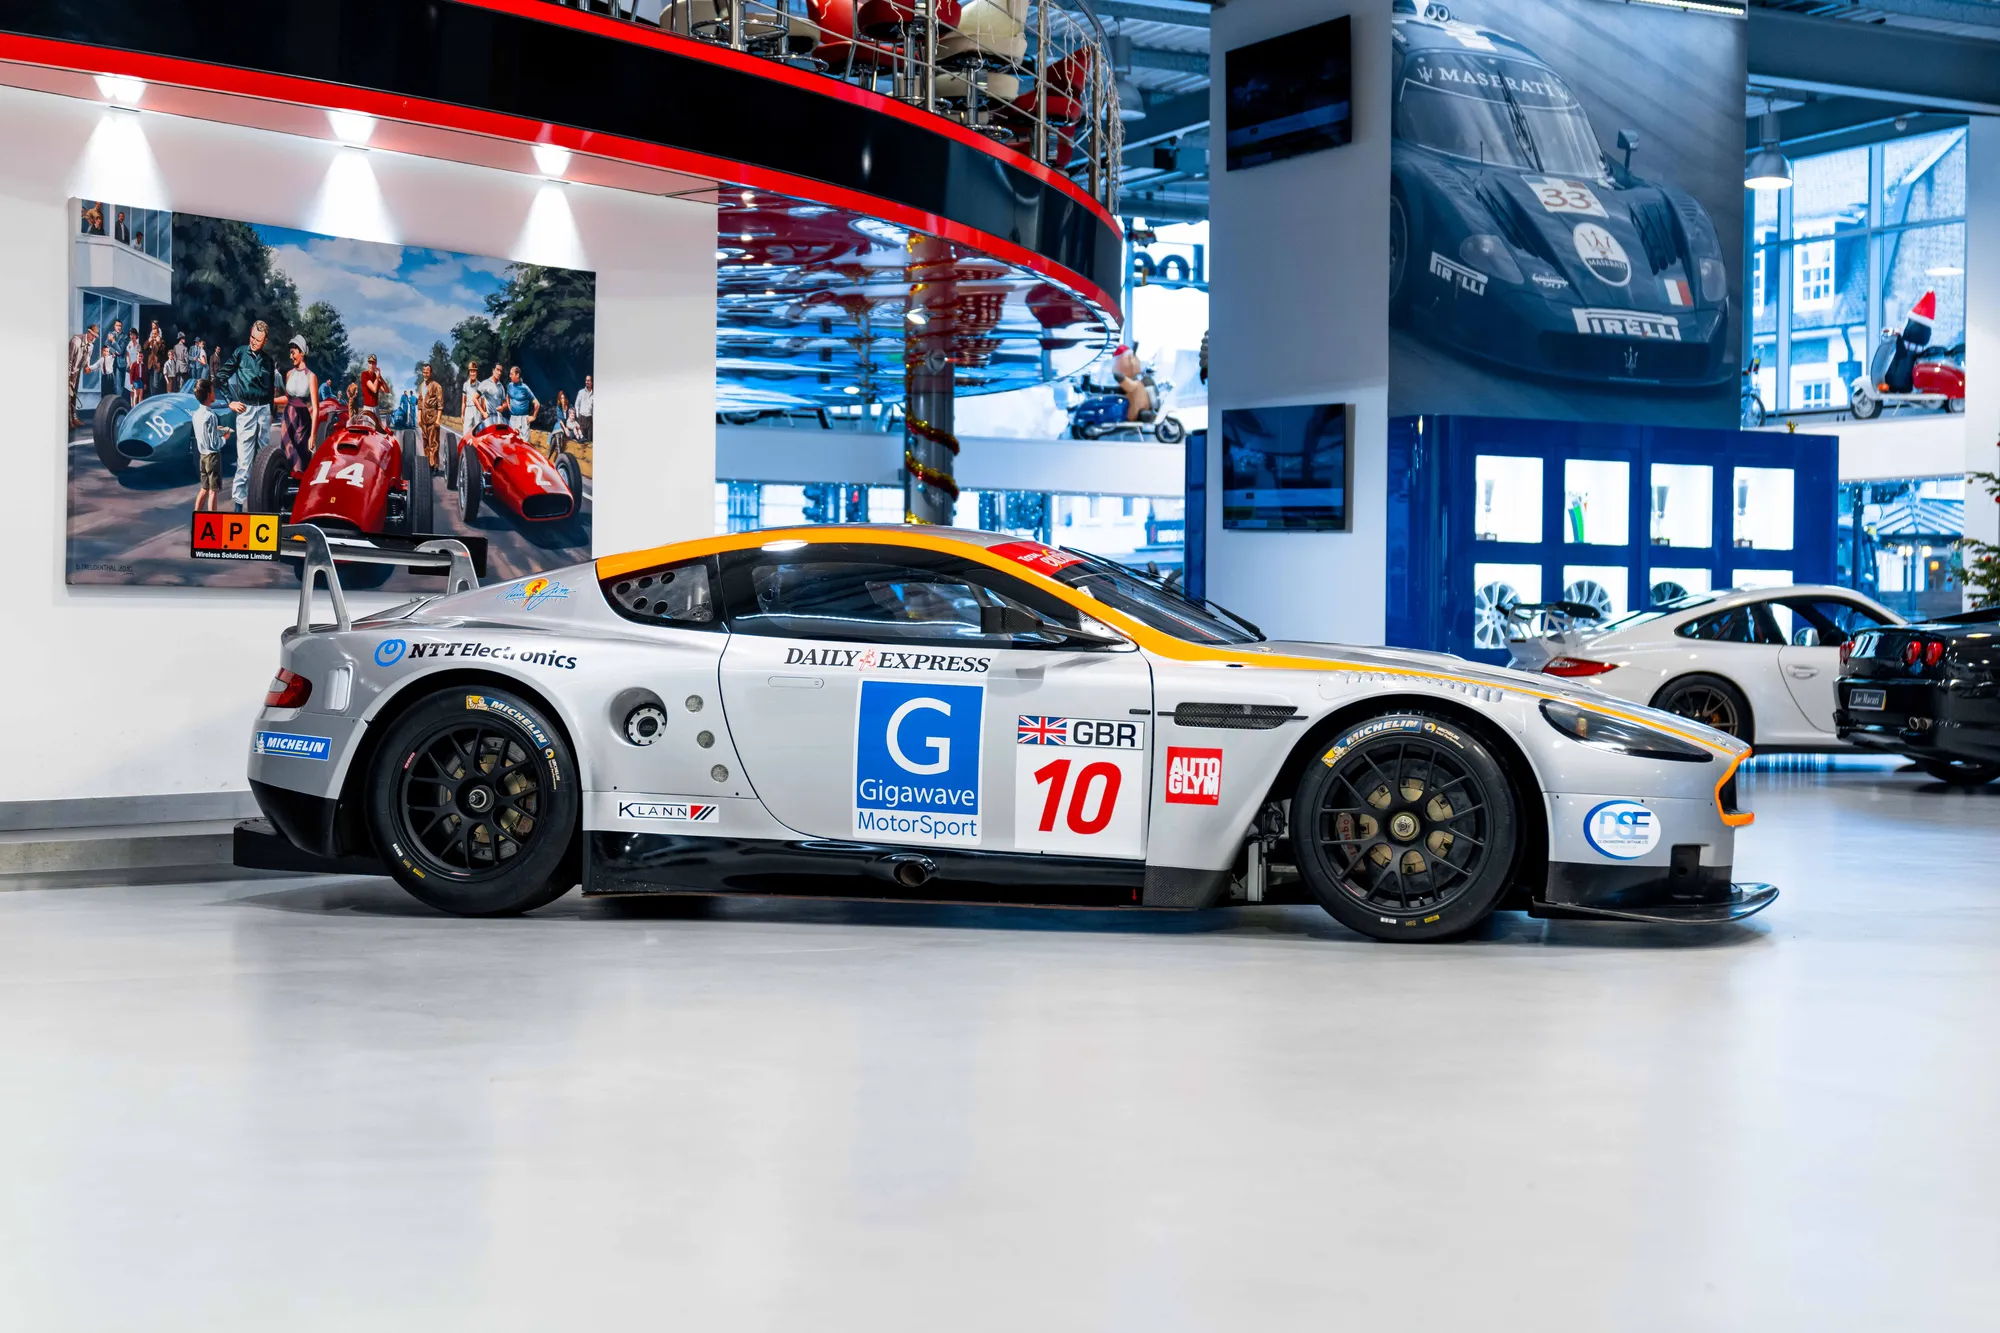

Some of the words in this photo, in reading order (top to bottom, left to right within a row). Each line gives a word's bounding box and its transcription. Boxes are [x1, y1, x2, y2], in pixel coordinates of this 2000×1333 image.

[1439, 66, 1558, 98] MASERATI
[1542, 188, 1592, 210] 33
[1572, 308, 1682, 341] PIRELLI
[145, 414, 174, 439] 18
[309, 460, 365, 489] 14
[195, 551, 220, 559] Wireless
[784, 647, 862, 667] DAILY
[877, 652, 991, 673] EXPRESS
[491, 700, 548, 744] MICHELIN
[1073, 721, 1136, 748] GBR
[1346, 719, 1419, 746] MICHELIN
[266, 736, 326, 753] MICHELIN
[886, 697, 951, 776] G
[1169, 756, 1220, 777] AUTO
[859, 778, 975, 807] Gigawave
[1033, 758, 1122, 835] 10
[1168, 774, 1219, 796] GLYM
[618, 802, 687, 818] KLANN
[858, 811, 977, 839] MotorSport
[1598, 811, 1651, 840] DSE
